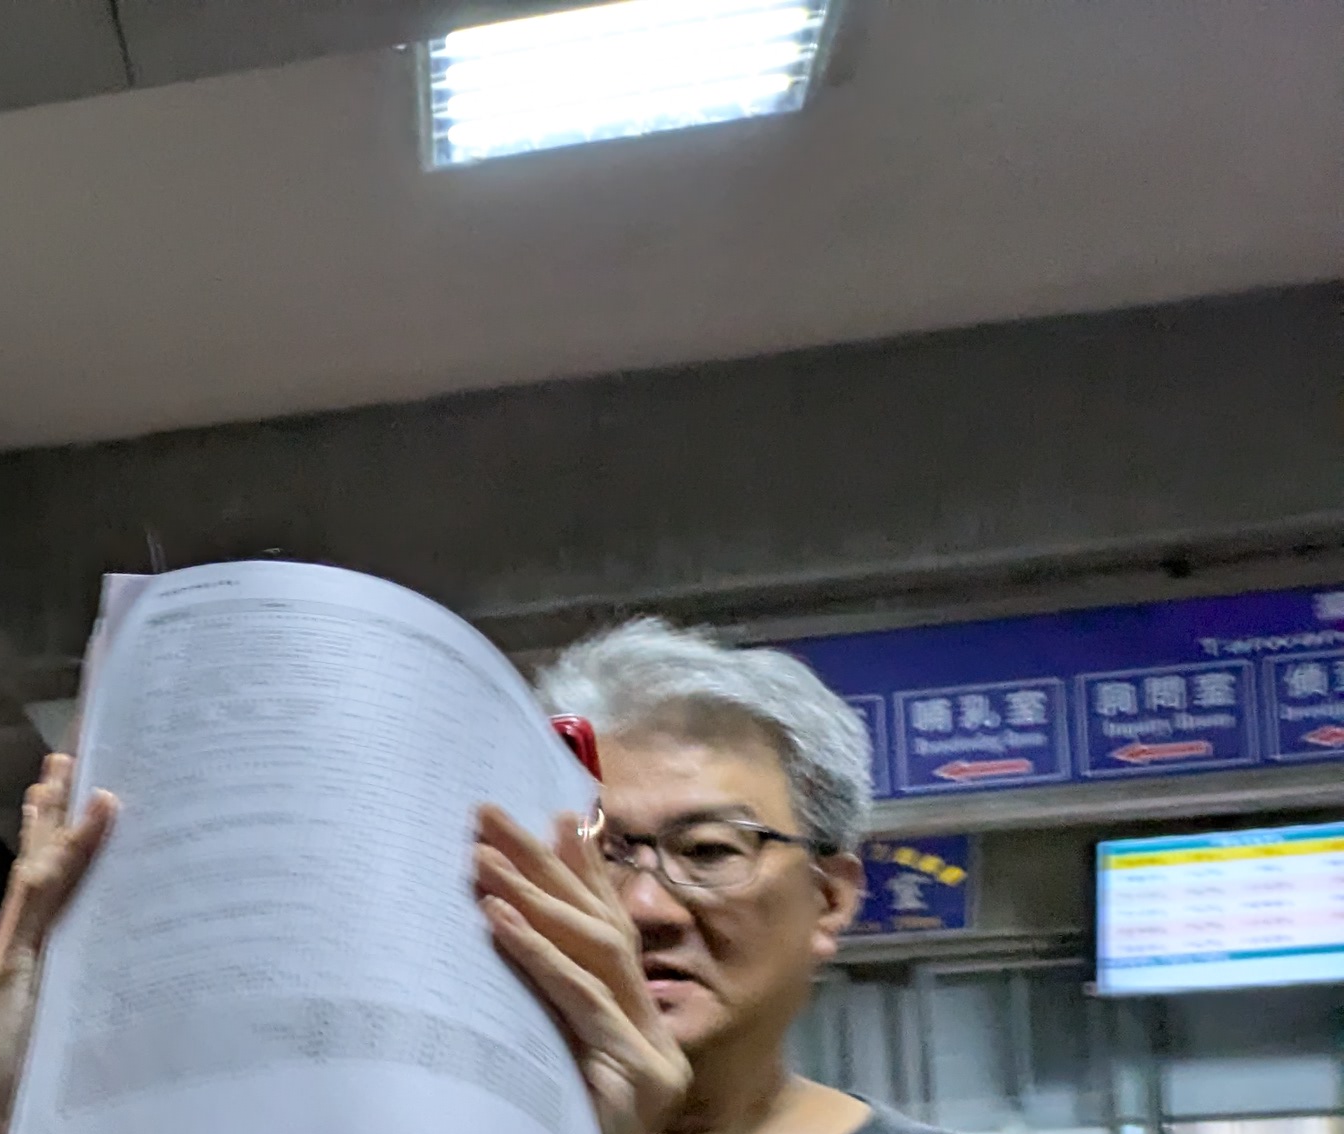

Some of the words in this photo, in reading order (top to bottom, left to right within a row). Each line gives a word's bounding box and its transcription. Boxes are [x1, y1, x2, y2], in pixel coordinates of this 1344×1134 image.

[912, 690, 1049, 733] 哺乳室
[1096, 672, 1236, 716] 詢問室
